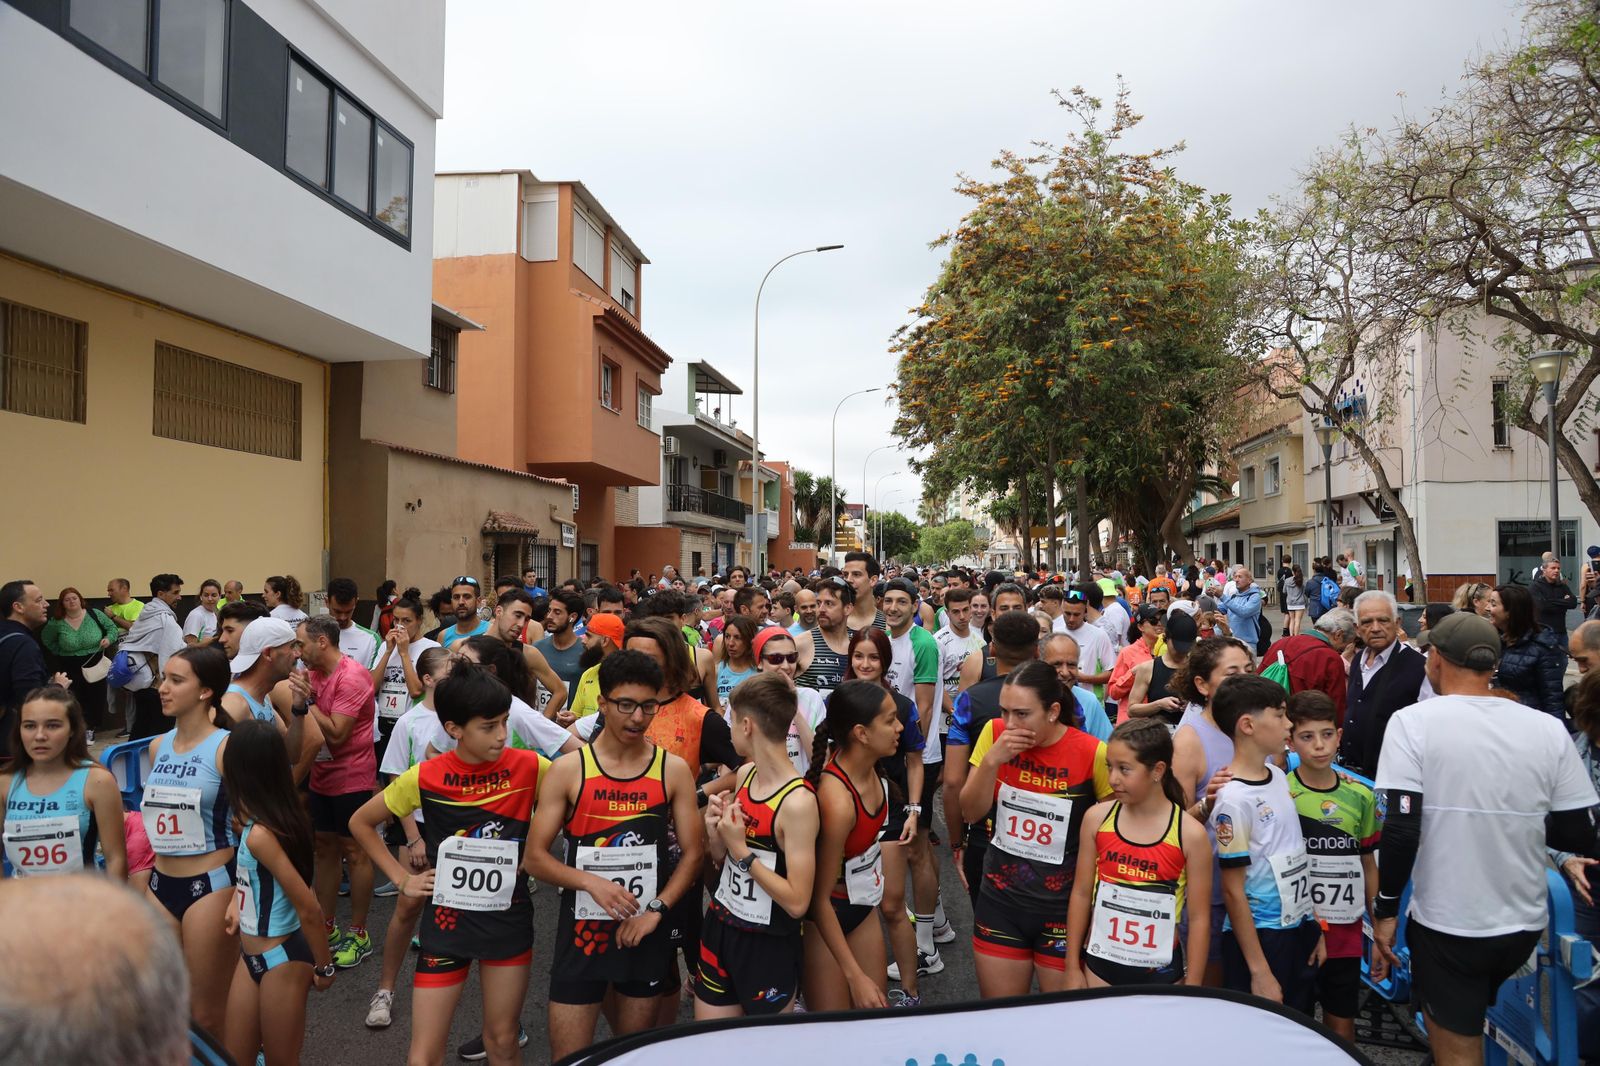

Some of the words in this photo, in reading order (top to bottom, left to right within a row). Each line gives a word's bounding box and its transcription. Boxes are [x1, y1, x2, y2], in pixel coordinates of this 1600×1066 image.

[386, 696, 397, 708] 74
[153, 761, 197, 778] nerja
[443, 768, 511, 786] Málaga
[461, 778, 511, 796] Bahía
[1019, 770, 1068, 791] Bahía
[7, 799, 60, 814] nerja
[593, 789, 648, 803] Málaga
[608, 801, 648, 811] Bahía
[156, 813, 182, 835] 61
[1006, 815, 1053, 846] 198
[18, 843, 68, 867] 296
[1105, 850, 1159, 871] Málaga
[451, 866, 503, 893] 900
[1117, 863, 1157, 881] Bahía
[1290, 876, 1309, 904] 72
[1310, 883, 1355, 906] 674
[1107, 916, 1158, 949] 151
